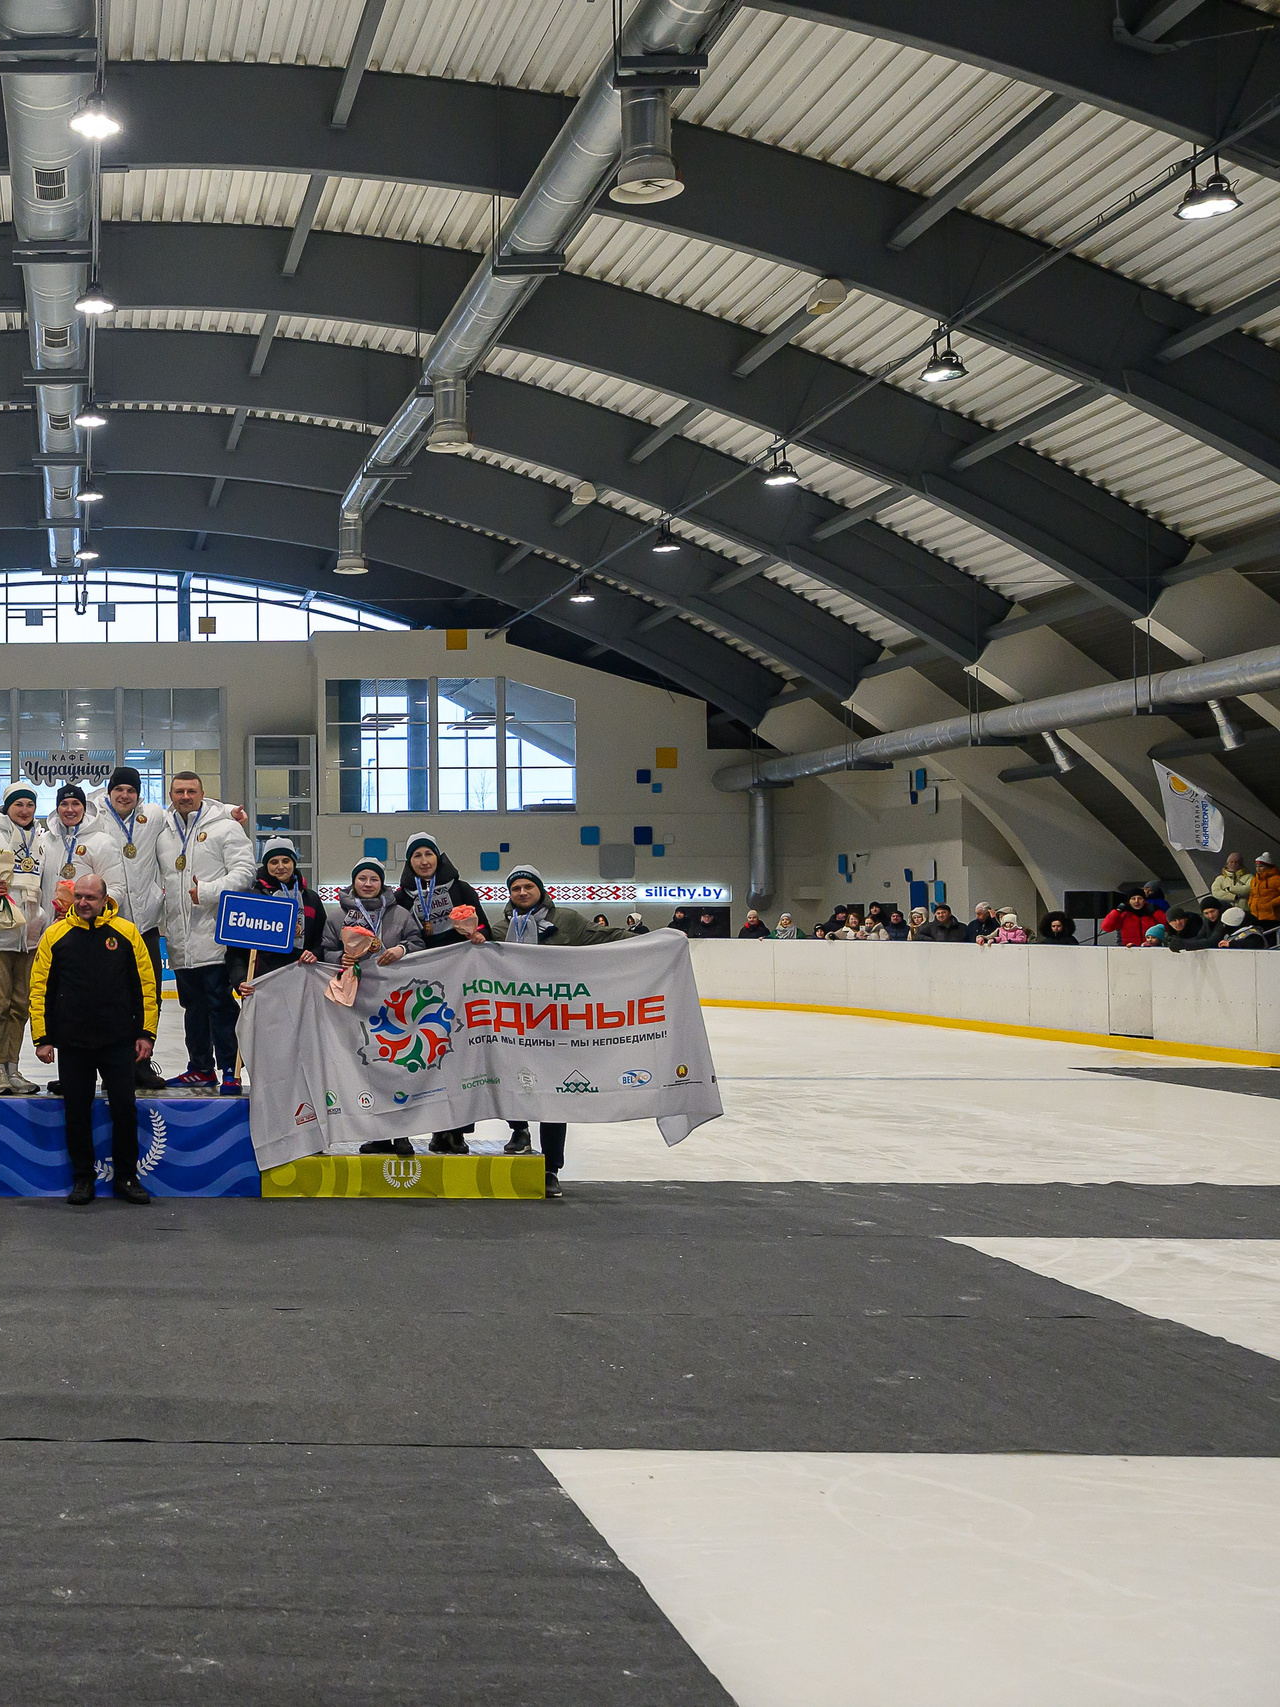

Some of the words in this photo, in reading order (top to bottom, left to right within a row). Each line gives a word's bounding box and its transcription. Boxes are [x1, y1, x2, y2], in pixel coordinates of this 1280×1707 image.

[51, 753, 85, 762] КАФЕ
[24, 760, 111, 782] Чараўніца
[645, 886, 723, 900] silichy.by
[228, 911, 284, 933] Единые
[462, 979, 591, 1000] КОМАНДА
[464, 995, 666, 1035] ЕДИНЫЕ
[468, 1034, 499, 1046] КОГДА
[501, 1035, 516, 1045] МЫ
[519, 1037, 555, 1048] ЕДИНЫ
[570, 1038, 589, 1048] МЫ
[592, 1030, 668, 1047] НЕПОБЕДИМЫ!
[389, 1160, 416, 1178] III
